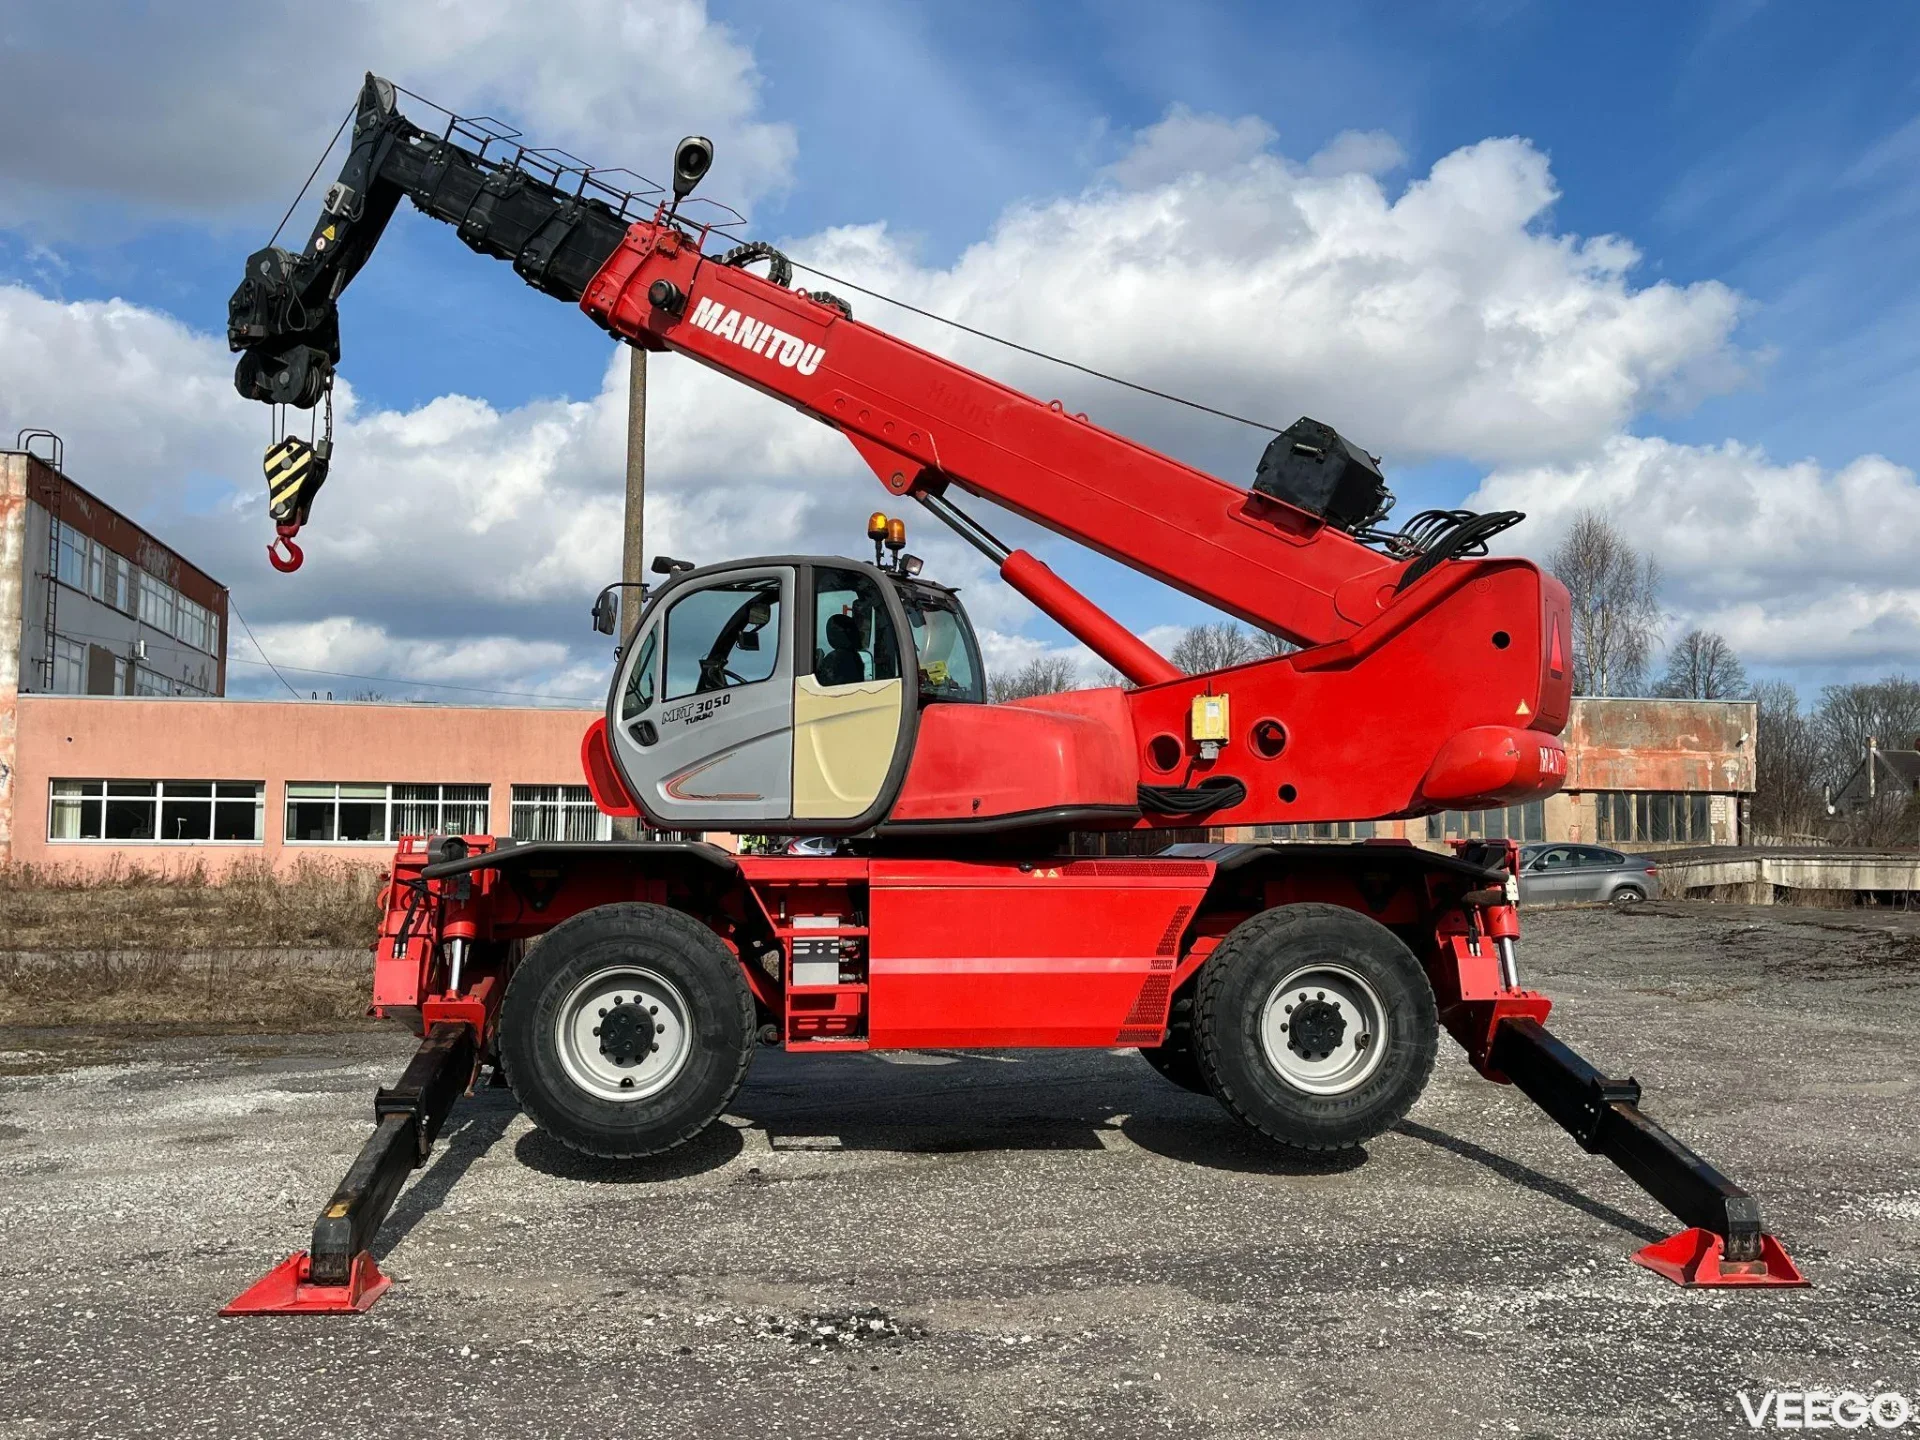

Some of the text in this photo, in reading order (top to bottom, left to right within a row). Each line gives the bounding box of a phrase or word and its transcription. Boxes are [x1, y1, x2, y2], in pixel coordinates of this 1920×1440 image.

[689, 296, 826, 376] MANITOU
[661, 694, 731, 725] MRT 3050
[685, 711, 714, 726] TURBO
